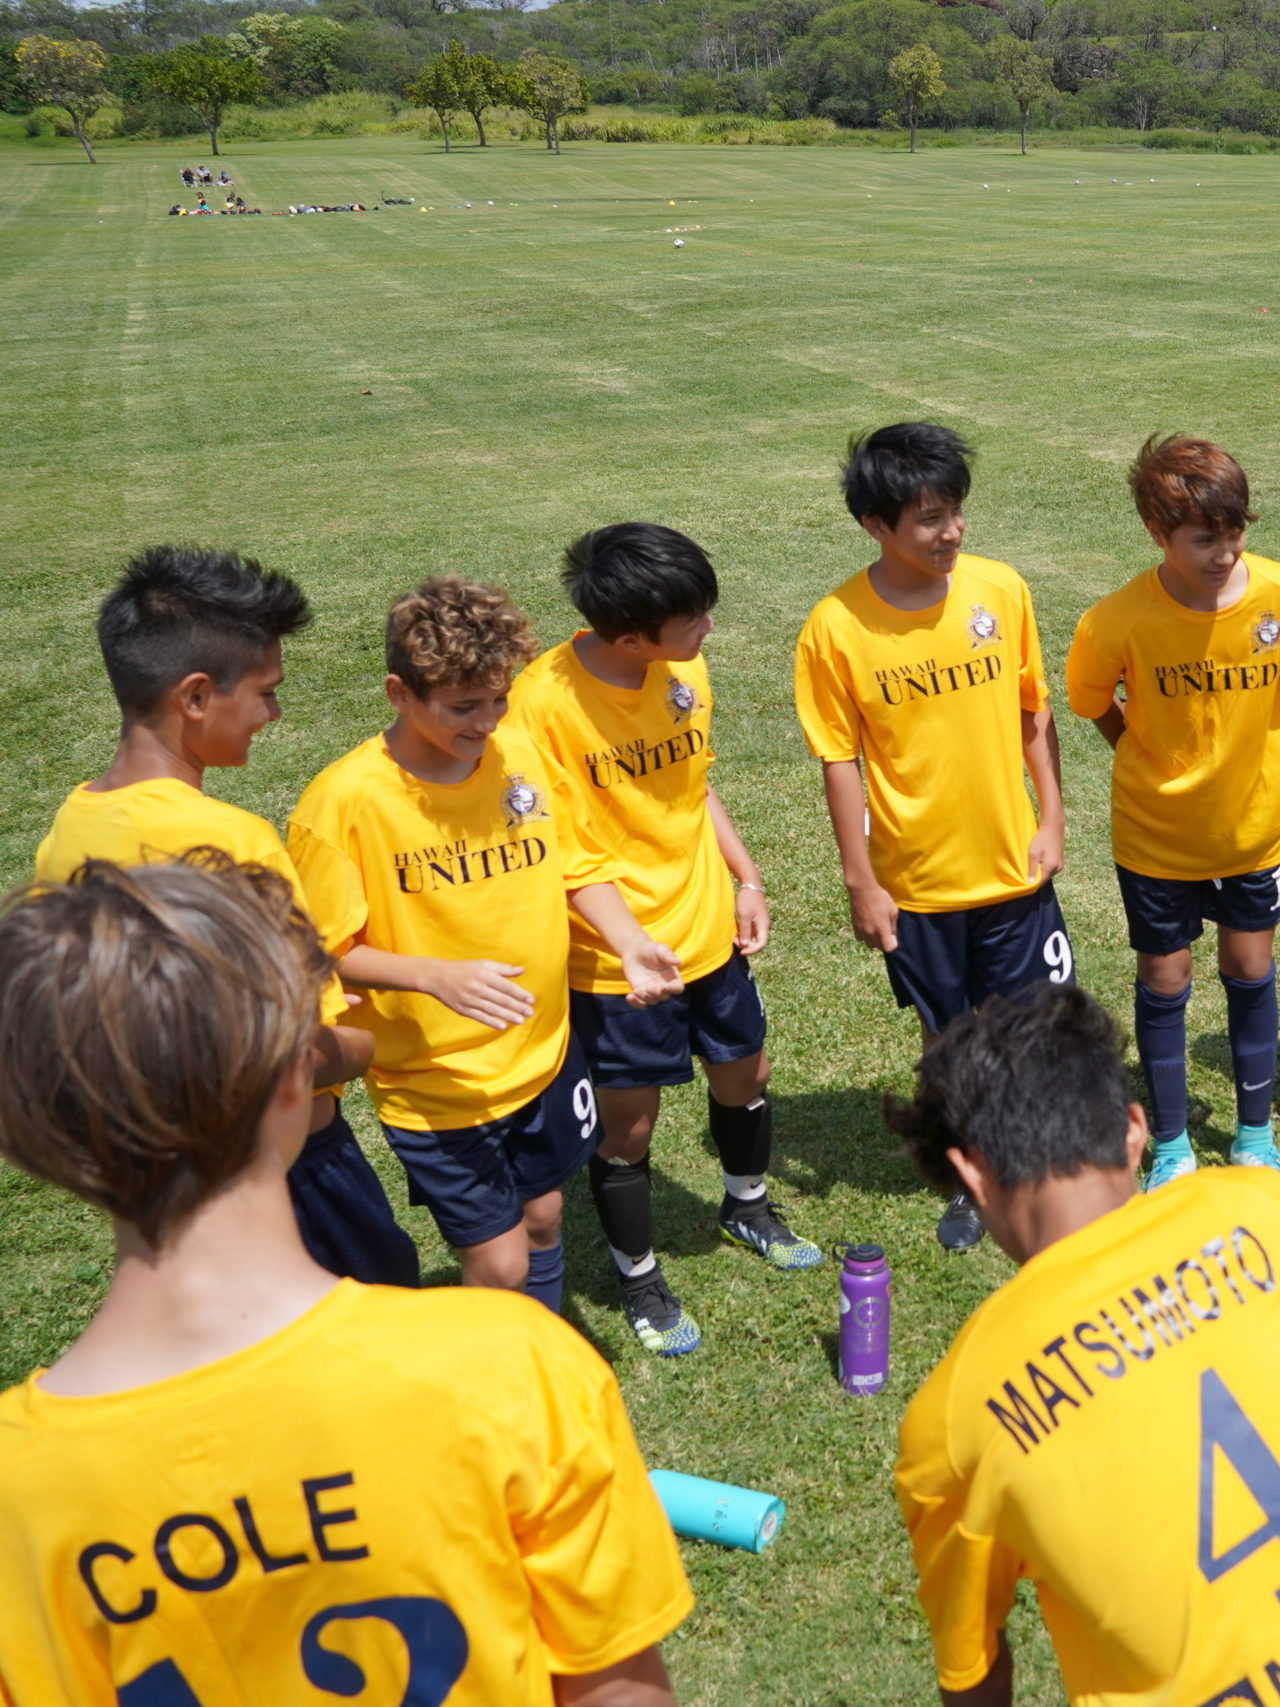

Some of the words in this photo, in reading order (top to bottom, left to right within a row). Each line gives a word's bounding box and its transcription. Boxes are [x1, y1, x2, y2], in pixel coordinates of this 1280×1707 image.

[875, 658, 937, 683] HAWAII
[879, 654, 1002, 706] UNITED
[1155, 659, 1214, 677] HAWAII
[1158, 663, 1278, 698] UNITED
[585, 738, 645, 765] HAWAII
[587, 728, 704, 789] UNITED
[394, 840, 467, 867] HAWAII
[396, 836, 547, 894] UNITED
[1043, 930, 1073, 985] 9
[573, 1078, 597, 1139] 9
[986, 1225, 1276, 1456] MATSUMOTO
[78, 1470, 371, 1625] COLE
